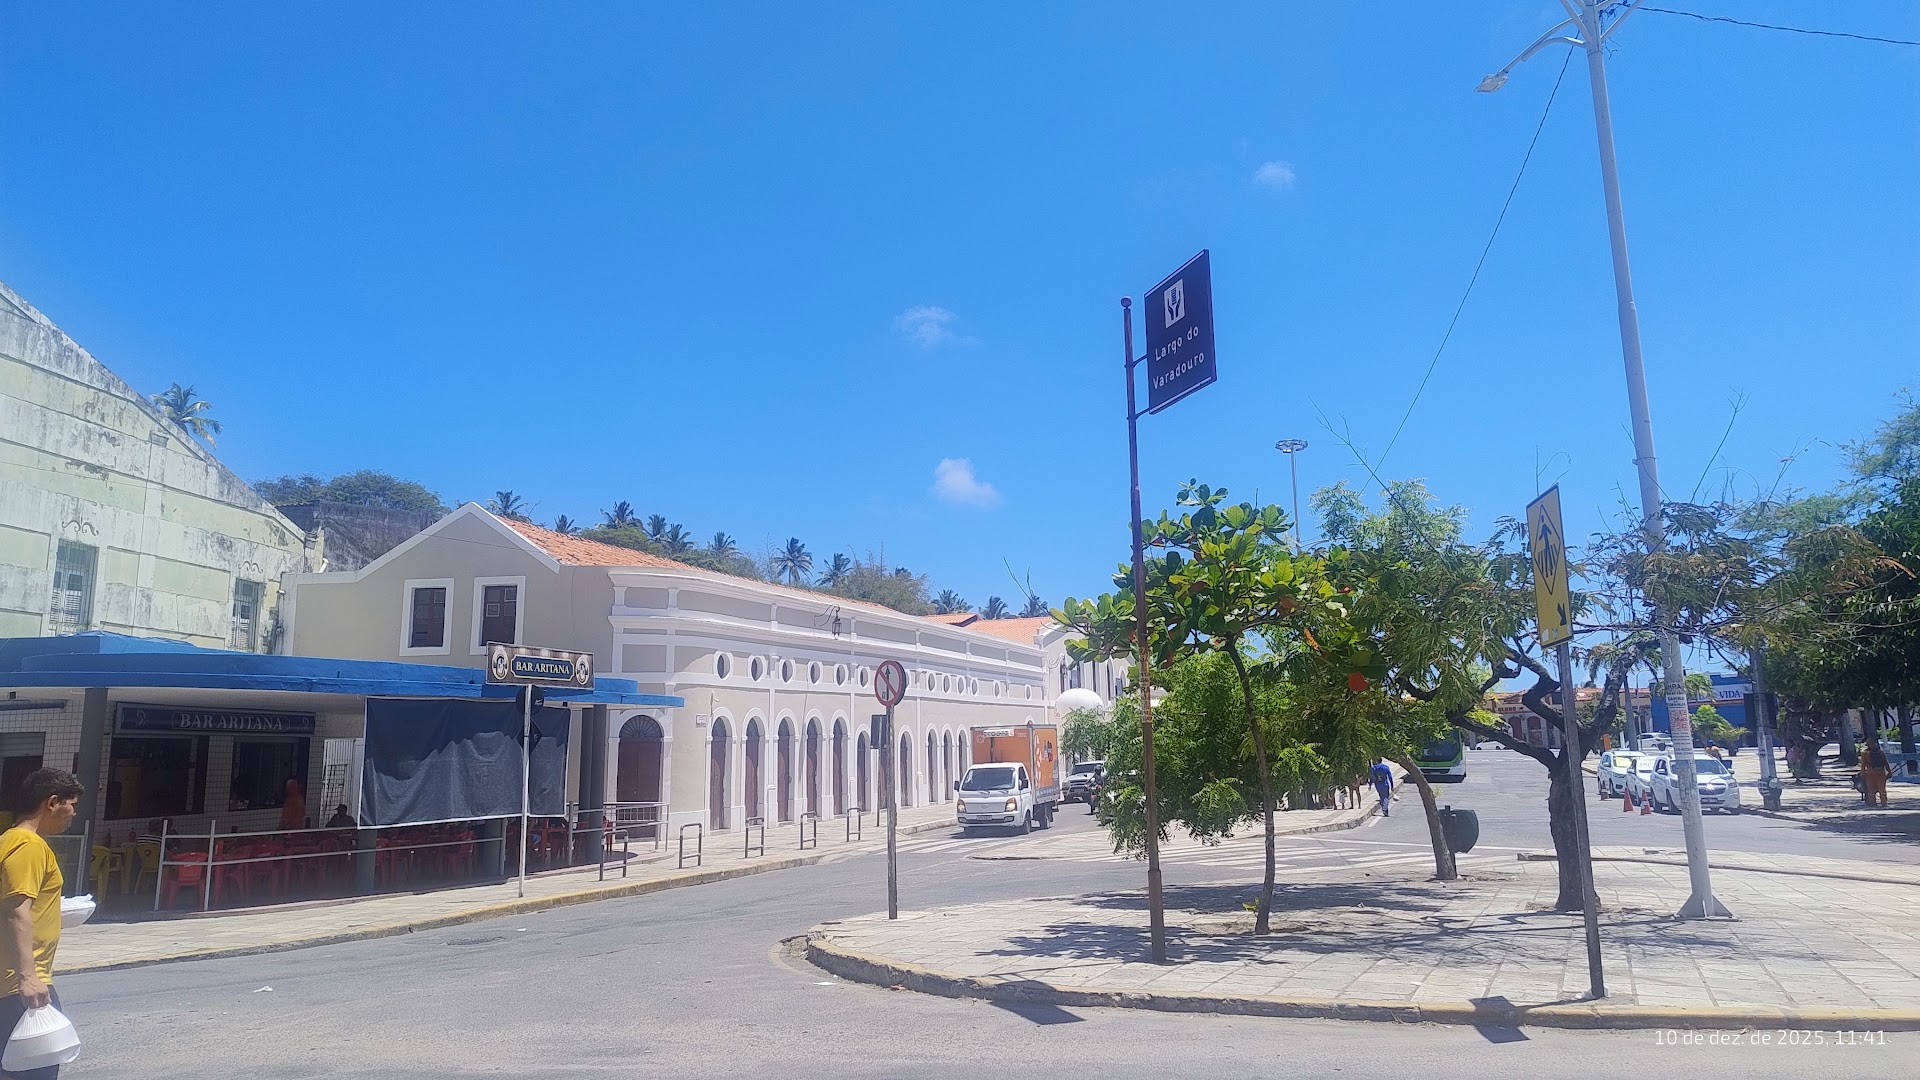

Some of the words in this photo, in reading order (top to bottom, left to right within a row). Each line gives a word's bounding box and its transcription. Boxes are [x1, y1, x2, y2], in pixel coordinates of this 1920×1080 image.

[1155, 337, 1183, 361] Largo
[1187, 326, 1199, 341] do
[1153, 352, 1204, 389] Varadouro
[516, 661, 533, 672] BAR
[534, 664, 570, 674] ARITANA
[1719, 689, 1741, 699] VIDA
[180, 713, 213, 729] BAR
[217, 715, 283, 730] ARITANA
